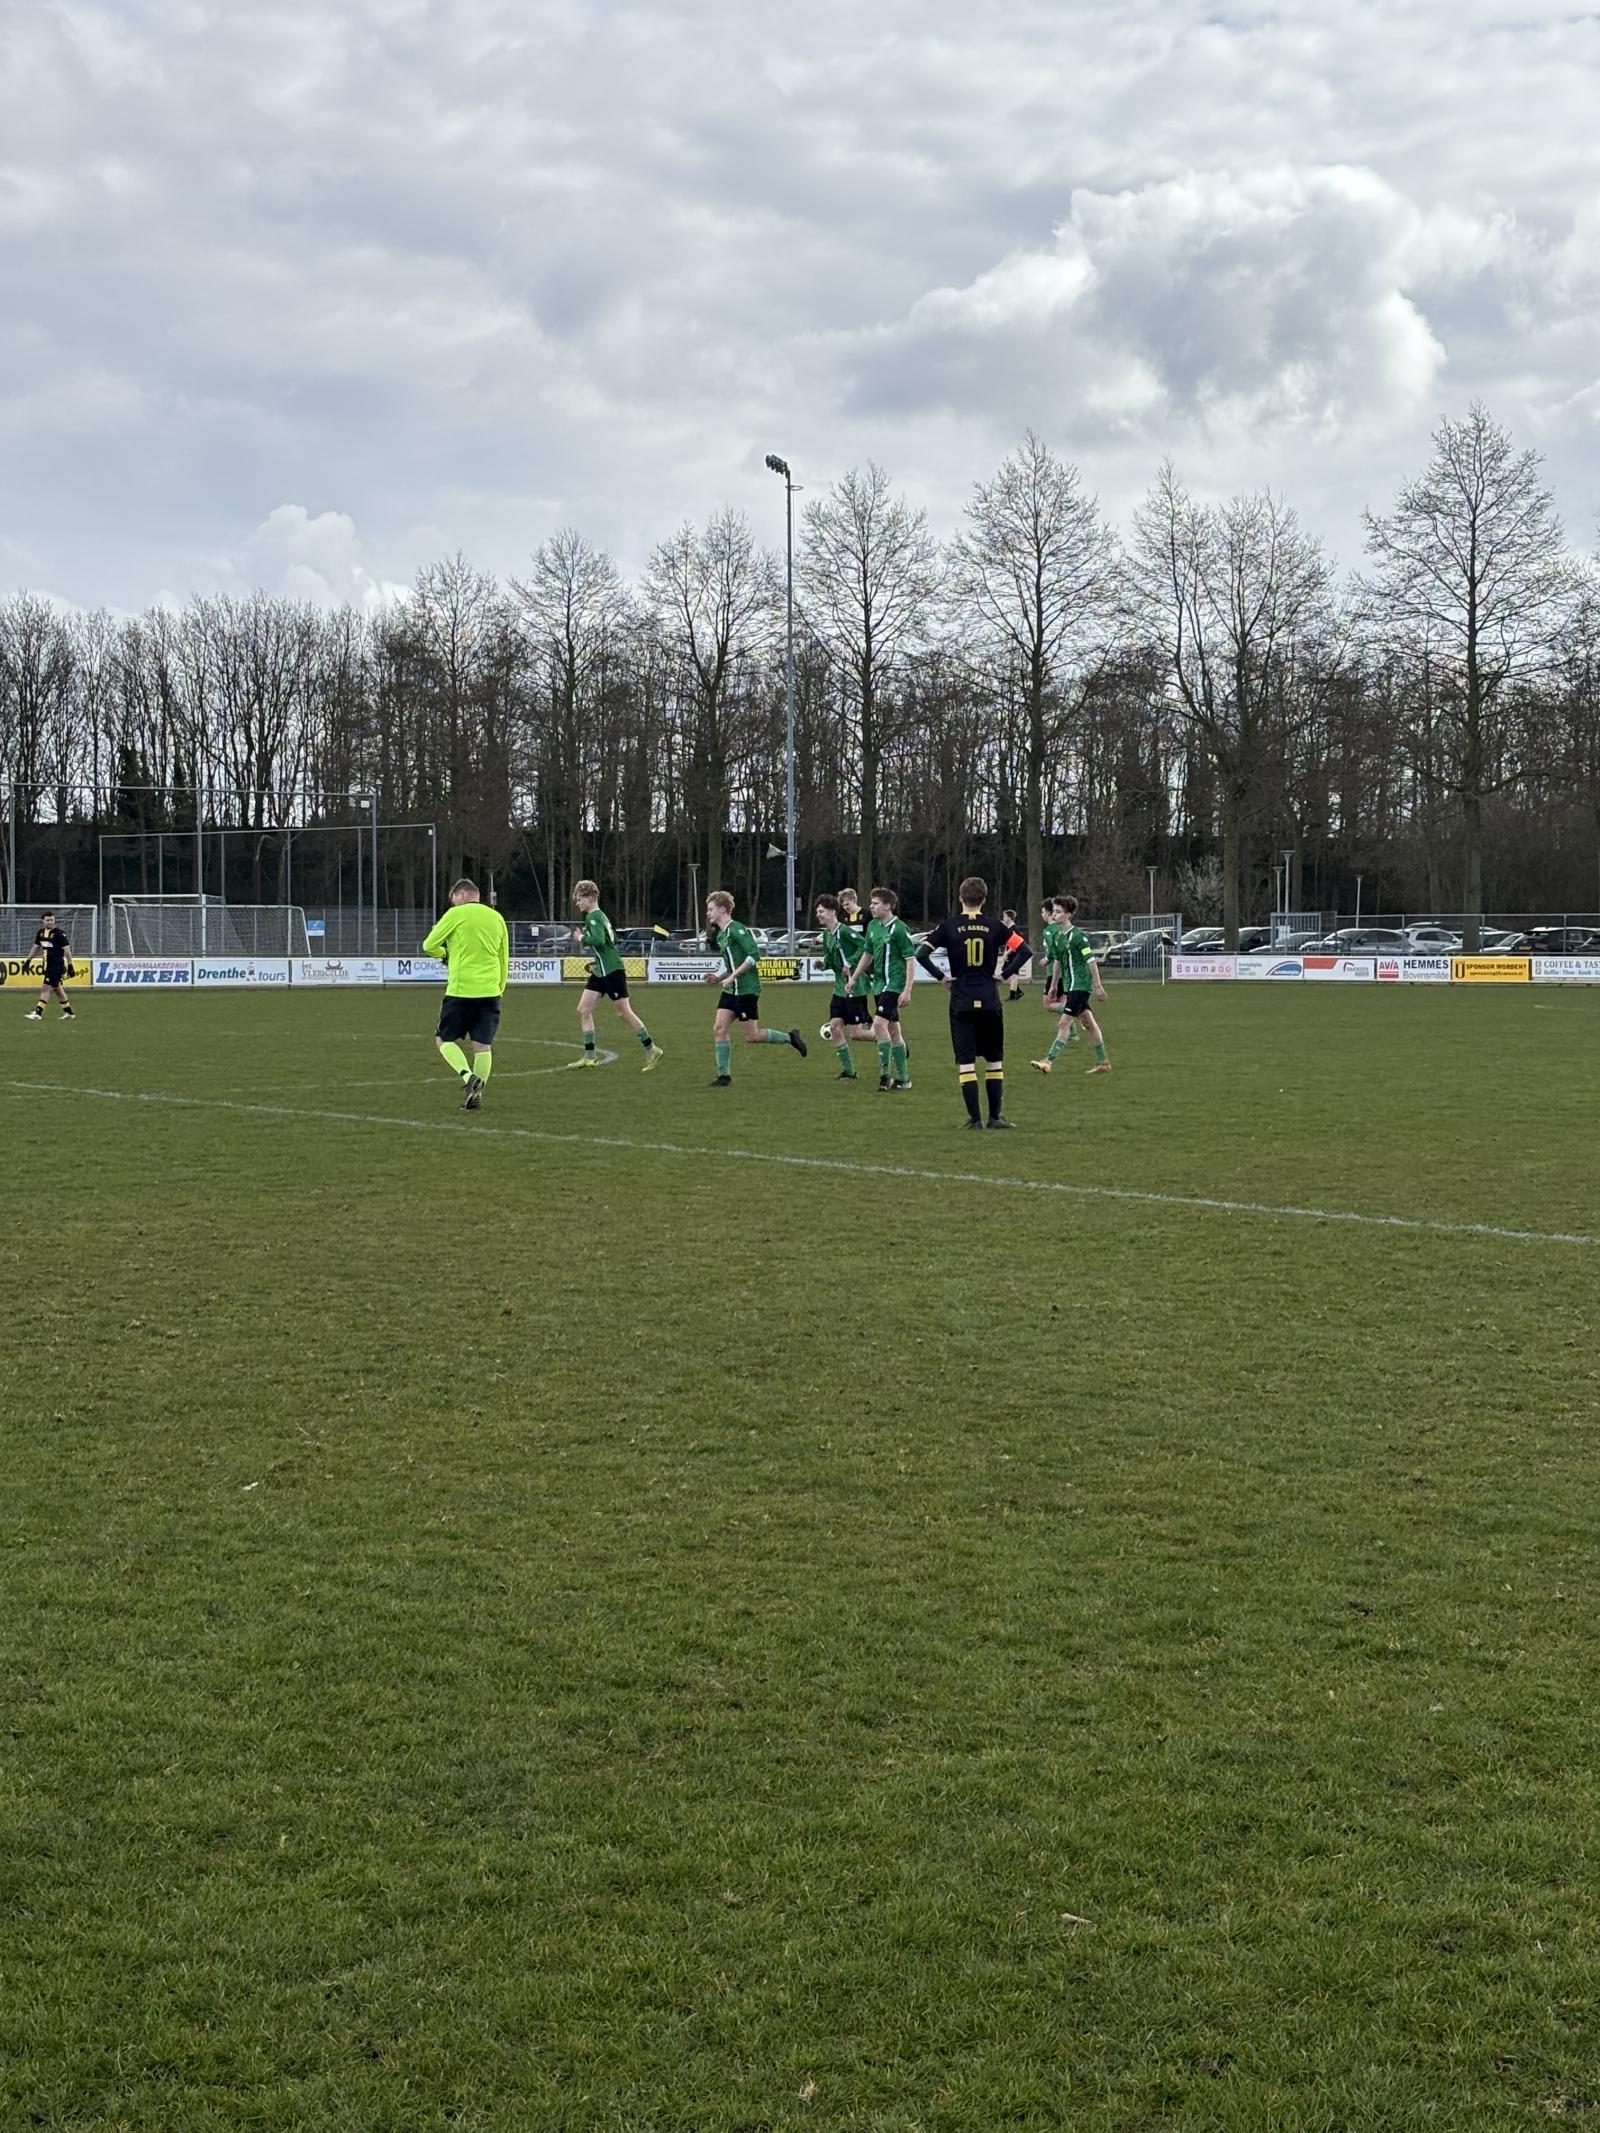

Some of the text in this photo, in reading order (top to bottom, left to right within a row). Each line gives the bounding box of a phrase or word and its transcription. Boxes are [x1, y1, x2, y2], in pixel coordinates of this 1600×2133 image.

[968, 925, 990, 933] ASSEN
[964, 937, 984, 967] 10
[1379, 960, 1399, 970] AVIA
[1403, 960, 1449, 969] HEMMES
[1544, 961, 1574, 969] COFFEE
[1575, 961, 1582, 969] &
[96, 962, 190, 983] LINKER
[197, 967, 247, 979] Drenthe
[258, 971, 286, 981] tours
[1403, 971, 1449, 979] Bovensmilde
